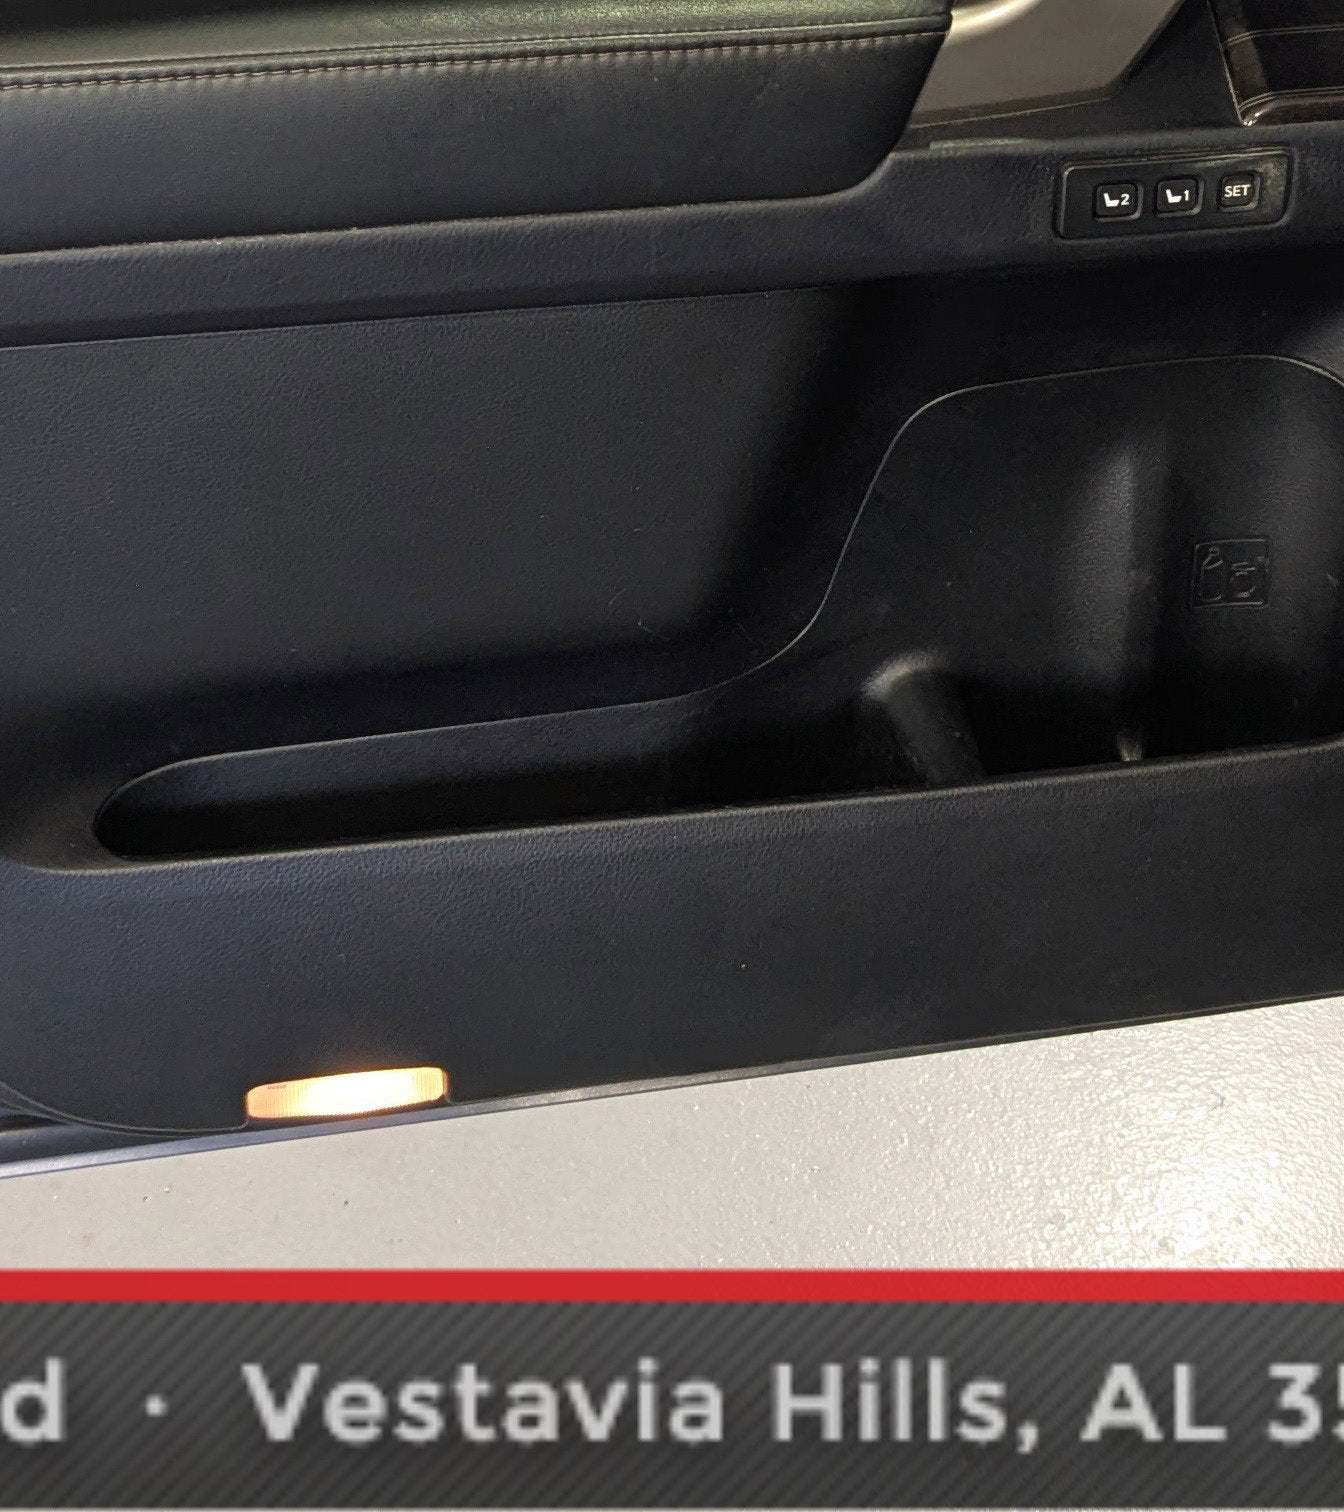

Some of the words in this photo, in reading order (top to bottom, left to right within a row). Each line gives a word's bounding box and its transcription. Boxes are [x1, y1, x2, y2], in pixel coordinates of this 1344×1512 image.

[1184, 190, 1190, 201] 1
[1224, 184, 1251, 198] SET
[1120, 194, 1130, 206] 2
